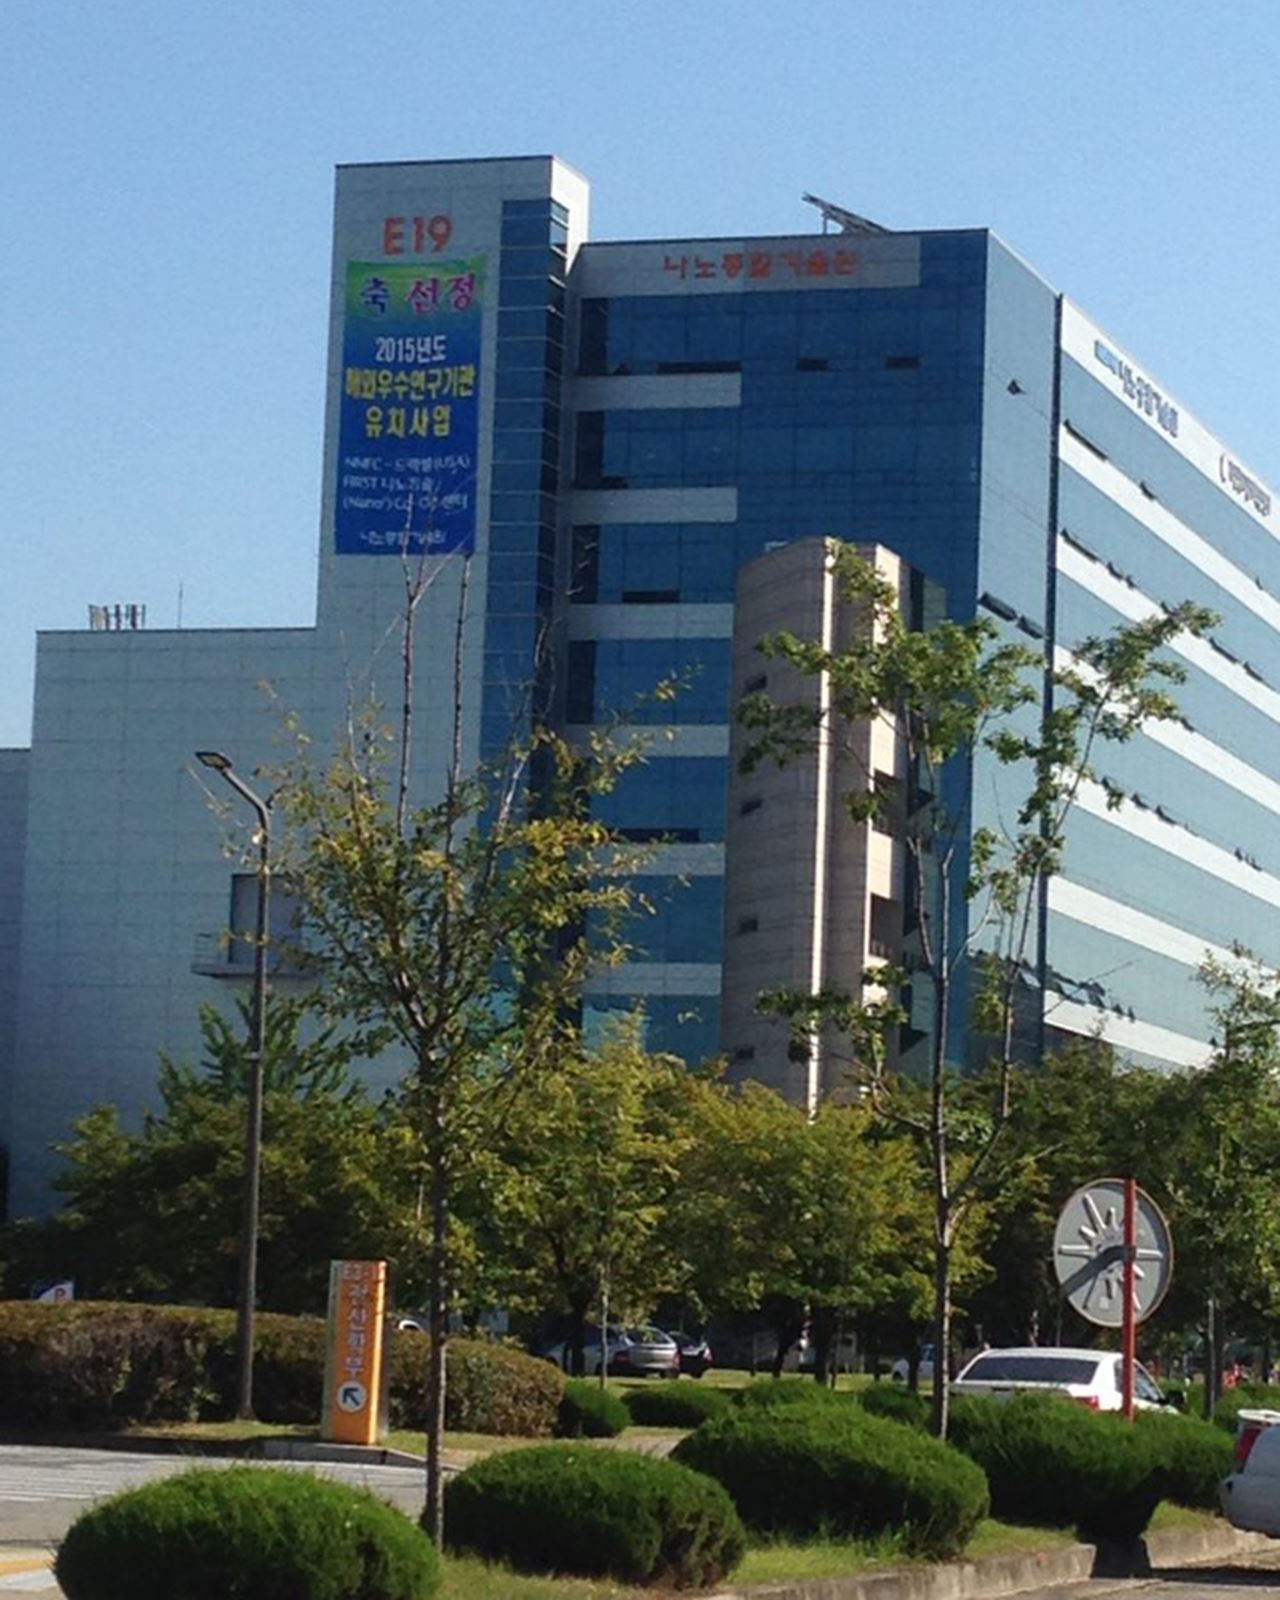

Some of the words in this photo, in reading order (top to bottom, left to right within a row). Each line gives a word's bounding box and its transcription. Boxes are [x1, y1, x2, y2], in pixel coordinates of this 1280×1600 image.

[383, 215, 453, 255] E19
[360, 277, 389, 314] 축
[405, 273, 475, 314] 선정
[375, 335, 447, 363] 2015년도
[365, 405, 451, 438] 유치사업
